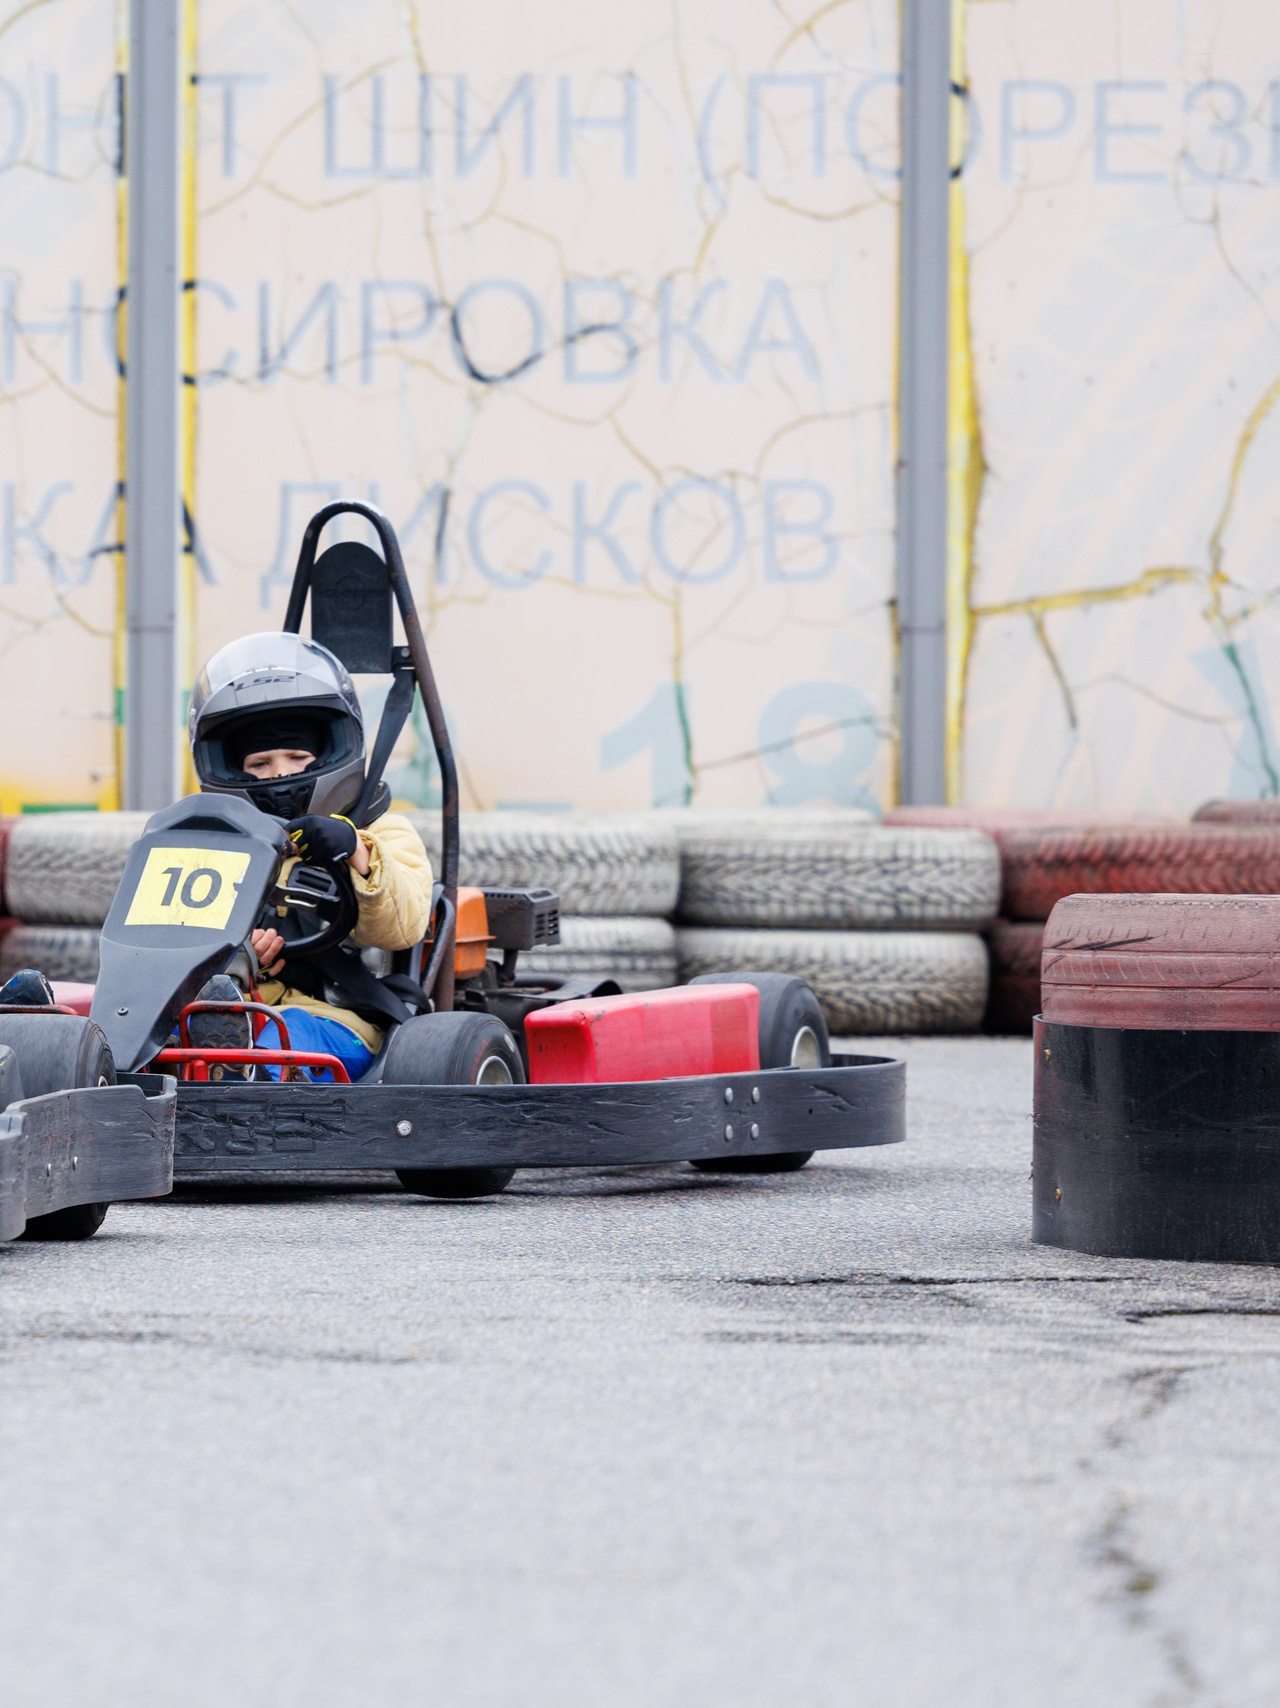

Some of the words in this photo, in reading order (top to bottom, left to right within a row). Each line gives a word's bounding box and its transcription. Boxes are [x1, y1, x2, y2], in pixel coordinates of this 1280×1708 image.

[322, 72, 638, 179] ШИН
[696, 72, 1280, 214] (ПОРЕЗ
[235, 674, 297, 692] LS2
[161, 867, 223, 909] 10
